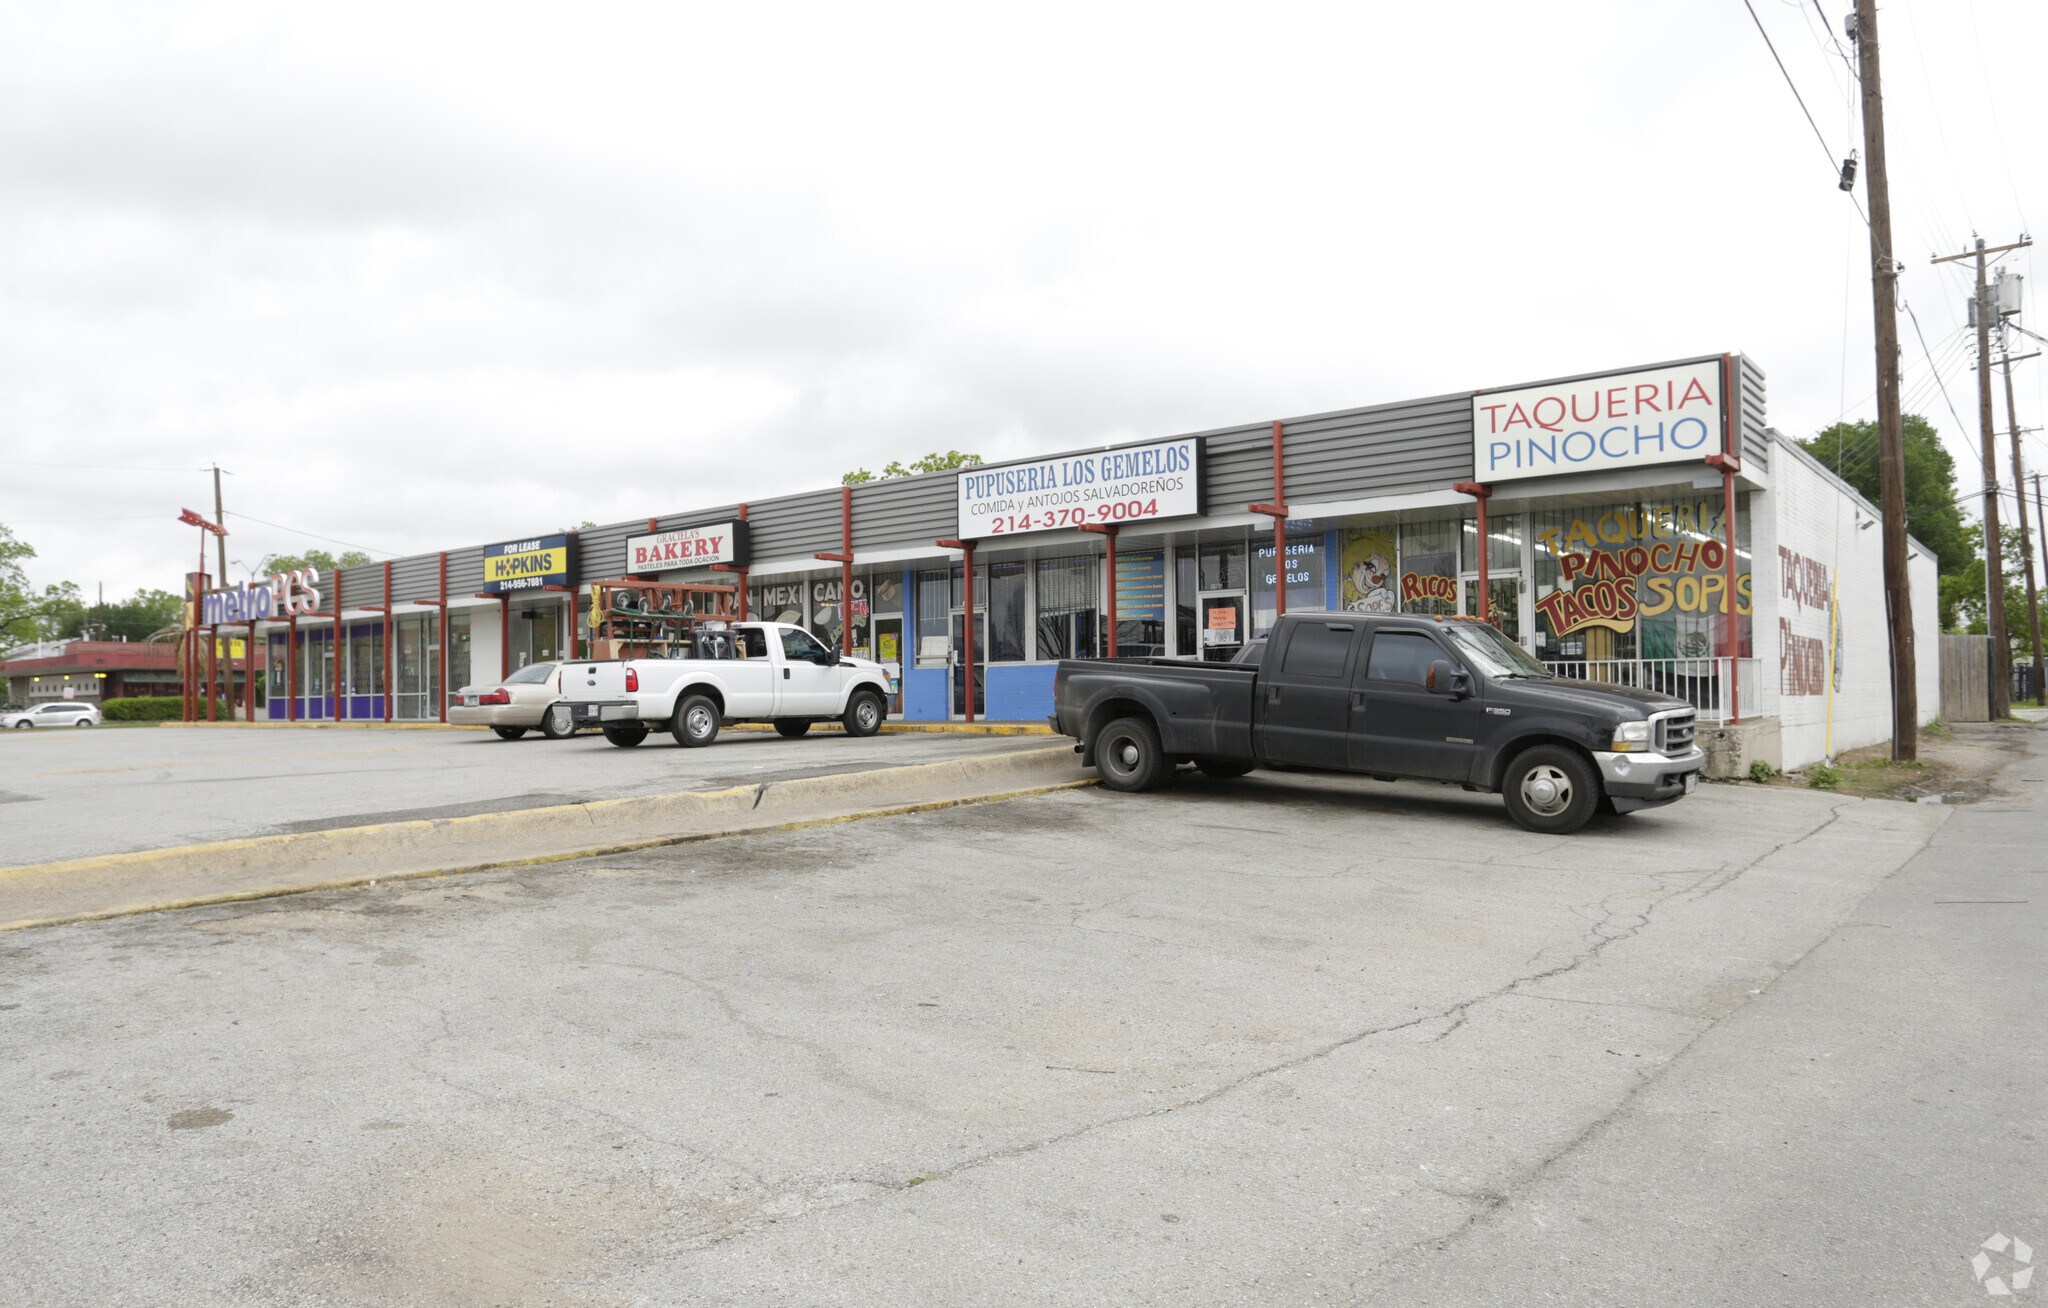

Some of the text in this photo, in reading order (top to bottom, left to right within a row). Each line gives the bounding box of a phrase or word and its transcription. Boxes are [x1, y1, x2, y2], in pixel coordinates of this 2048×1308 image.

[1480, 376, 1713, 434] TAQUERIA
[1490, 417, 1708, 471] PINOCHO
[965, 444, 1190, 500] PUPUSERIA LOS GEMELOS
[971, 500, 1015, 516] COMIDA
[1027, 490, 1080, 508] ANTOJOS
[1083, 476, 1184, 502] SALVADOREÑOS
[991, 498, 1159, 534] 214-370-9004
[504, 541, 541, 555] FOR LEASE
[635, 536, 724, 564] BAKERY
[656, 529, 700, 544] GRACIELA'S
[1258, 544, 1315, 559] PUPSERIA
[637, 561, 663, 571] PASTELES
[664, 559, 678, 568] PARA
[679, 557, 693, 566] TODA
[1265, 571, 1310, 585] GEELOS
[1560, 538, 1725, 582] PINOCHO
[1778, 543, 1830, 616] TAQUERIA
[1535, 576, 1639, 638] TACOS
